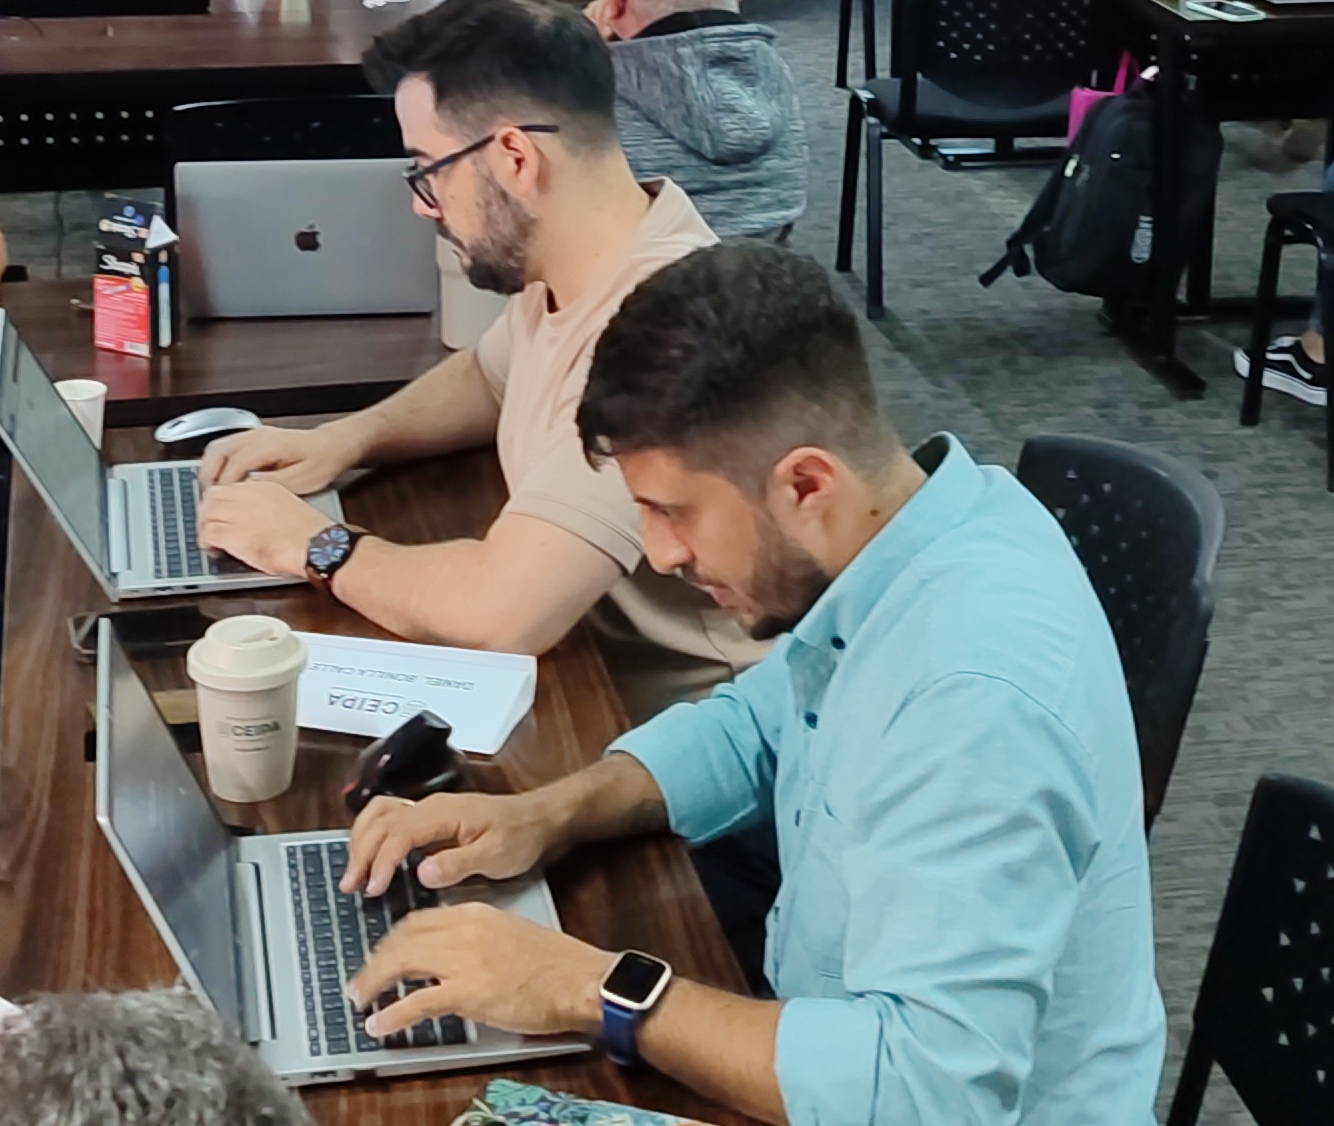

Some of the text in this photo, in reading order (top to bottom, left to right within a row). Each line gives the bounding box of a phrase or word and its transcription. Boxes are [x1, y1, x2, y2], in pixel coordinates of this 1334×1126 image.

[357, 669, 417, 683] BONILLA
[424, 676, 475, 691] DANIEL
[328, 692, 399, 715] CEIPA
